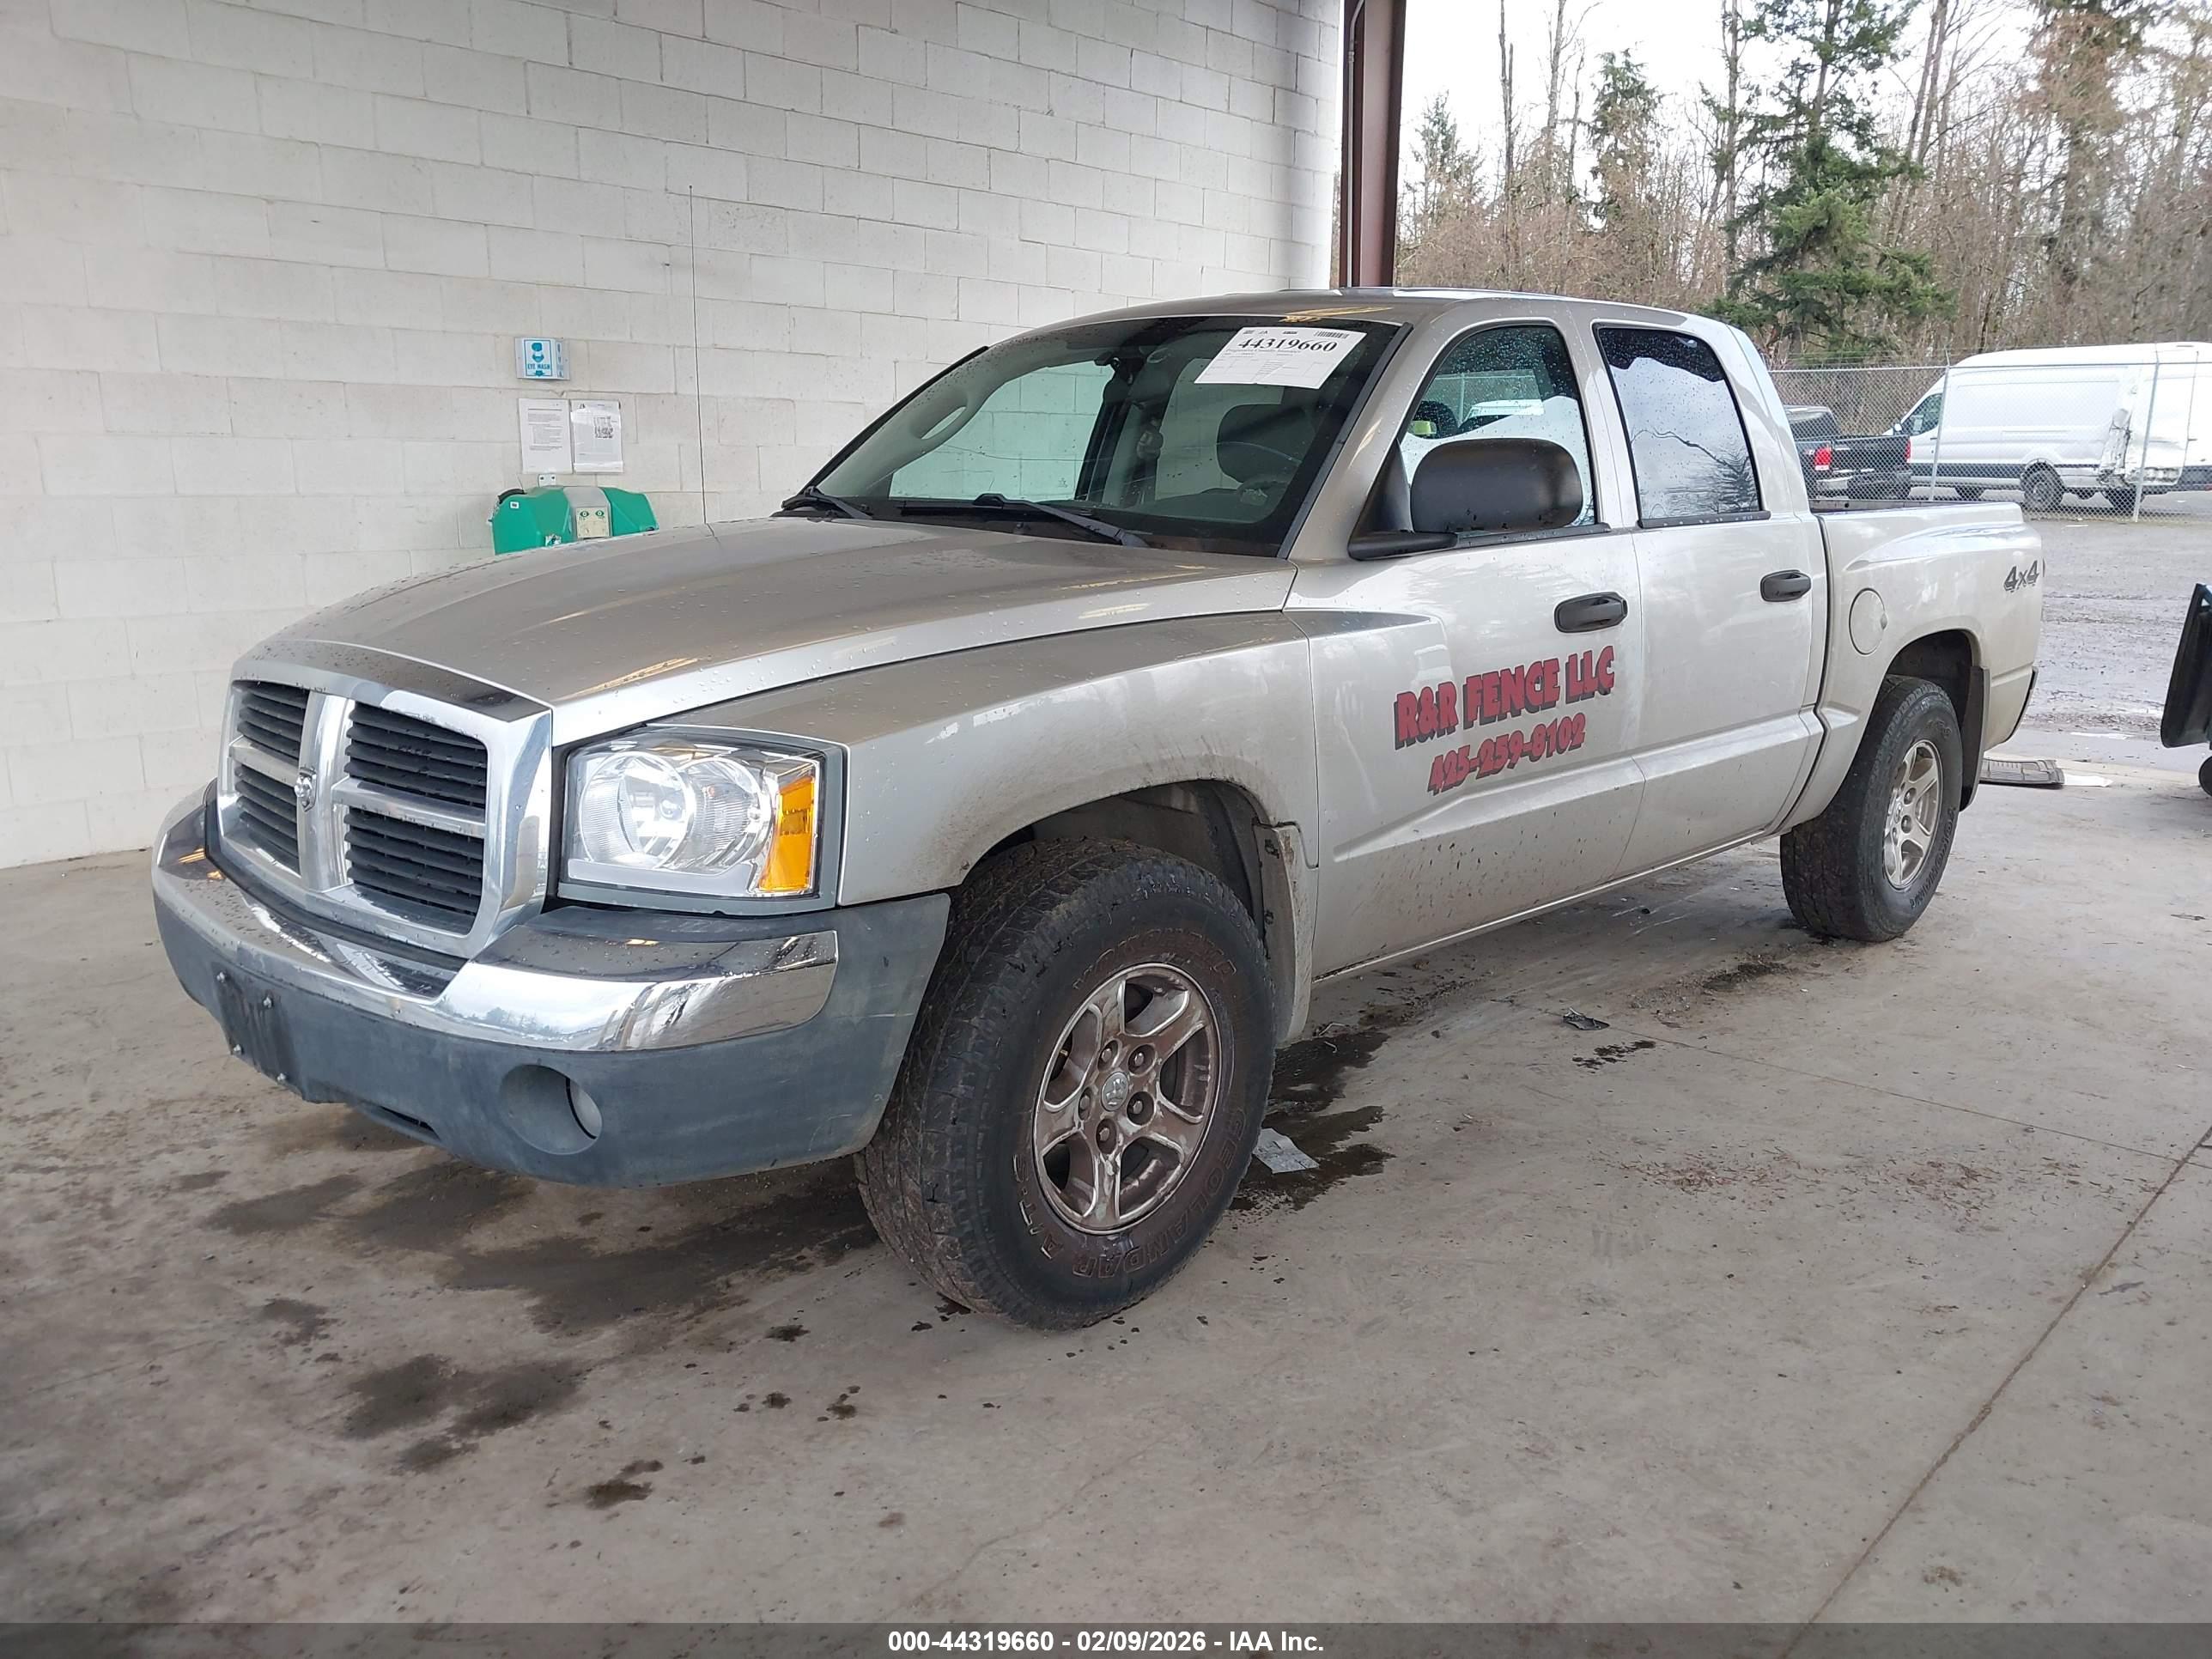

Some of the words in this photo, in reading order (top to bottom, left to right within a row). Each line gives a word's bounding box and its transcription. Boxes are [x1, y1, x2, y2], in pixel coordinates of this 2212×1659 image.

[1238, 337, 1338, 352] 44319660
[2003, 560, 2040, 592] 4x4
[1395, 681, 1459, 750] R&R
[1462, 658, 1560, 731] FENCE
[1565, 645, 1616, 705] LLC
